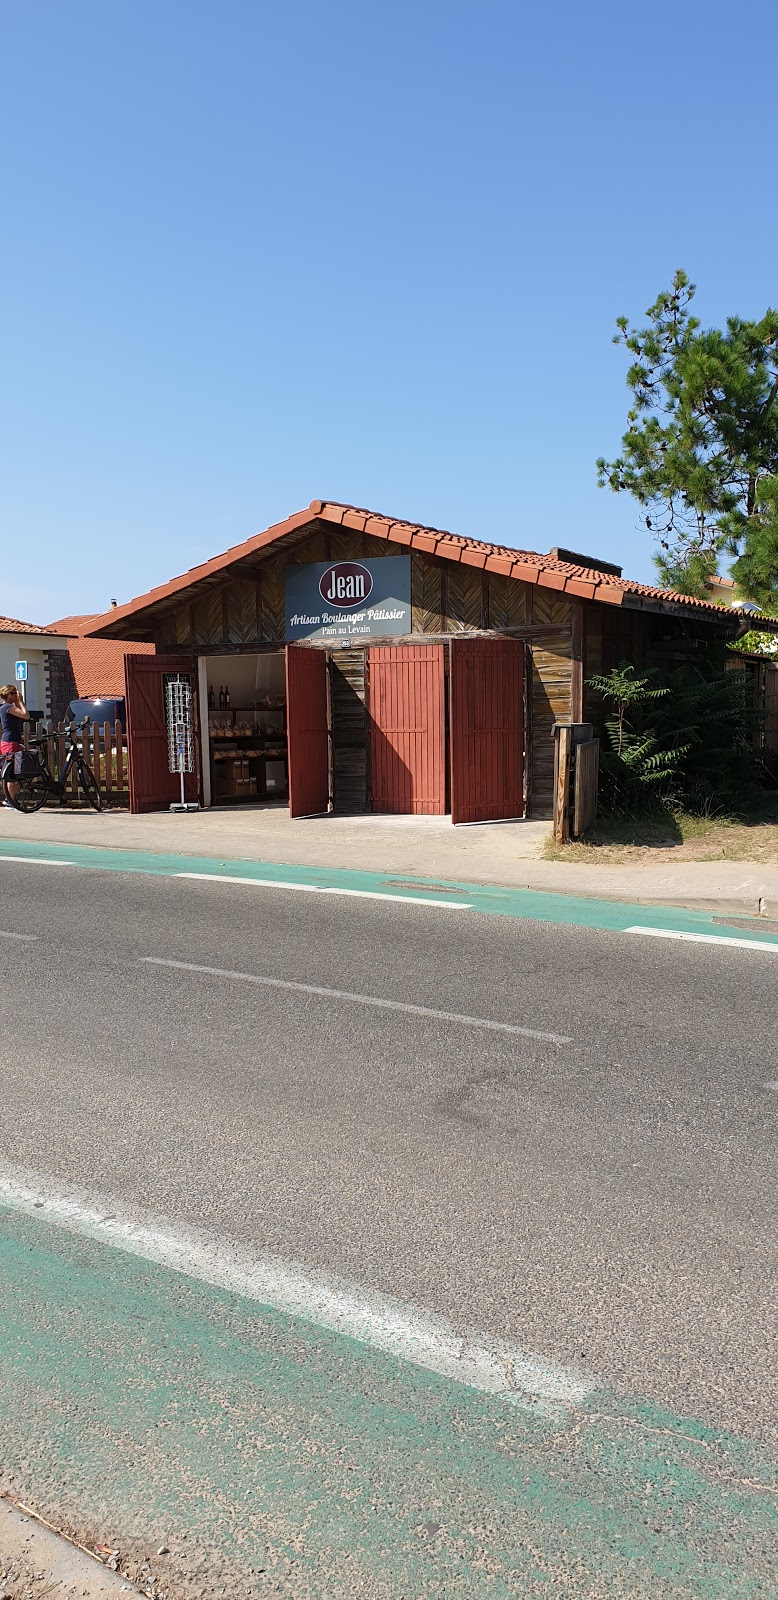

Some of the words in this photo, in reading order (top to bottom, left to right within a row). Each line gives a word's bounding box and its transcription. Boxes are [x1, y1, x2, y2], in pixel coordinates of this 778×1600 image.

[327, 571, 365, 599] Jean
[290, 615, 320, 626] Artisan
[322, 612, 366, 625] Boulanger
[367, 609, 406, 621] Pâtissier
[322, 627, 337, 635] Pain
[348, 625, 371, 634] Levain
